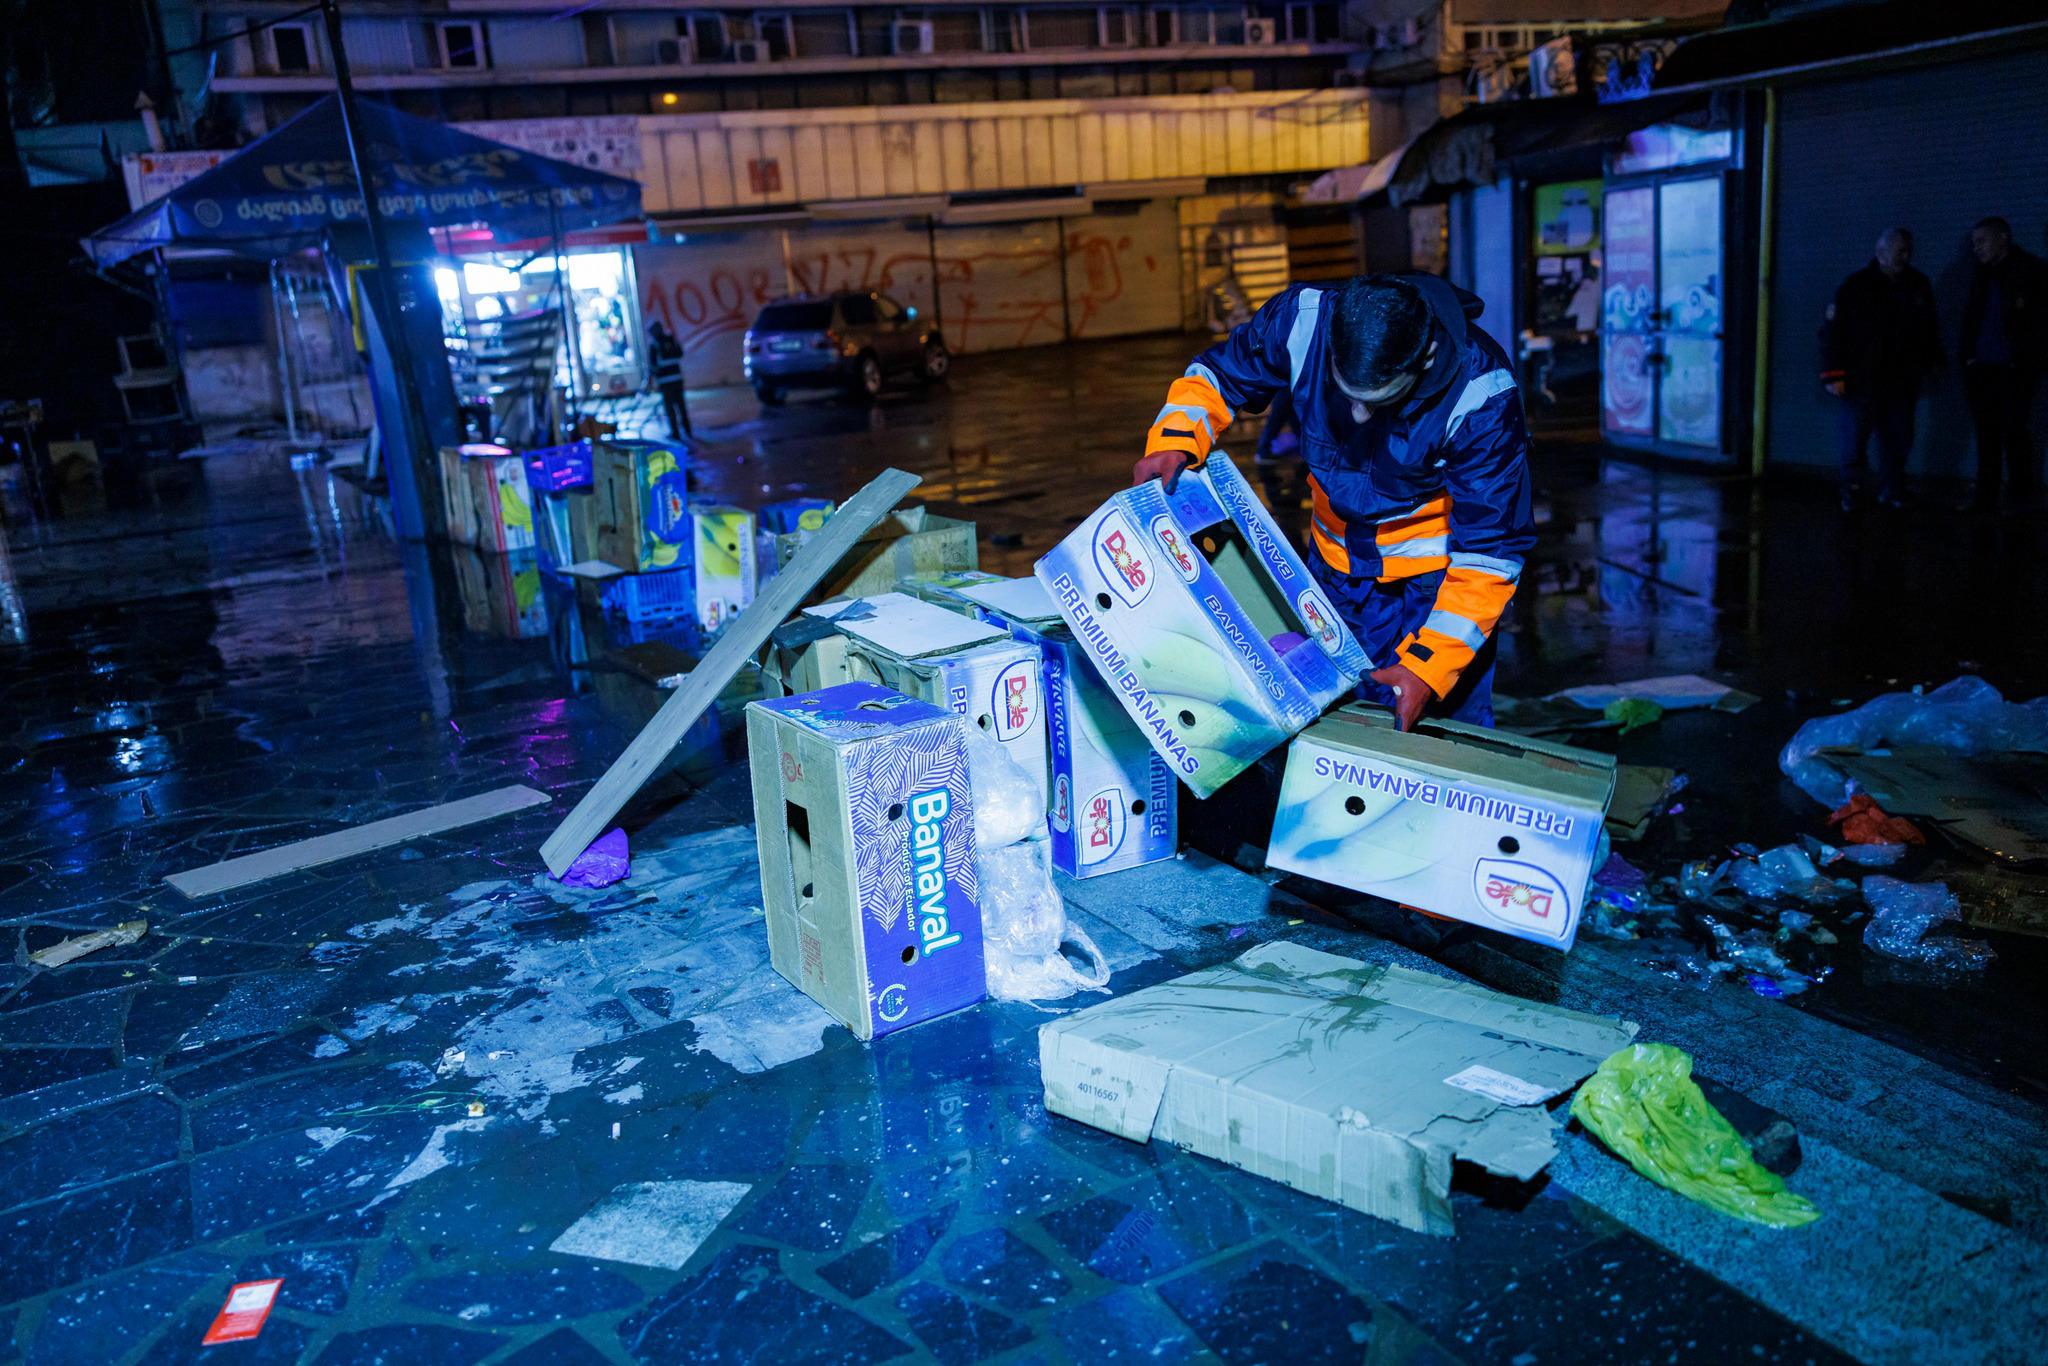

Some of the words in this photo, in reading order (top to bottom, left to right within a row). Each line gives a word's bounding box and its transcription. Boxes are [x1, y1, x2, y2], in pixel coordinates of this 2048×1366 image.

[1160, 529, 1192, 573] Dole
[1225, 481, 1295, 580] BANANAS
[1104, 530, 1147, 588] Dole
[1203, 594, 1286, 702] BANANAS
[1053, 572, 1128, 677] PREMIUM
[1117, 668, 1201, 776] BANANAS
[1009, 675, 1028, 729] Dole
[1314, 755, 1441, 806] BANANAS
[1091, 797, 1110, 848] Dole
[1446, 789, 1573, 837] PREMIUM
[901, 831, 912, 872] Product
[912, 791, 961, 956] Banaval
[904, 875, 912, 887] of
[1485, 878, 1553, 920] Dole
[905, 887, 916, 932] Ecuador
[1077, 1082, 1119, 1103] 40116567
